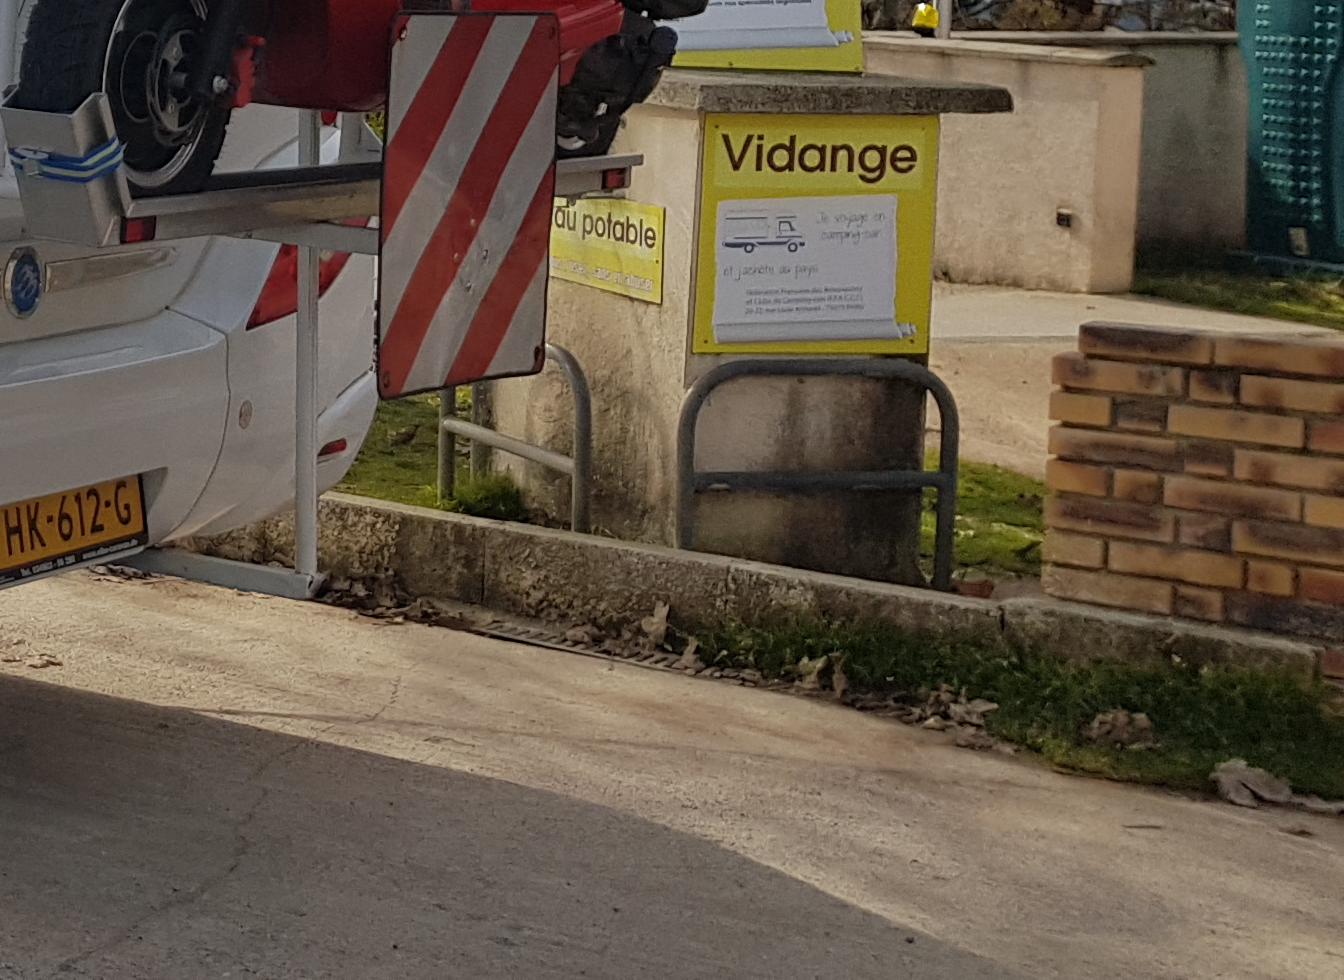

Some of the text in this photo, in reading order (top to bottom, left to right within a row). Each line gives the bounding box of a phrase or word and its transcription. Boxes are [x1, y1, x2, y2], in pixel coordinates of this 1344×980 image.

[721, 133, 918, 183] Vidange
[554, 207, 657, 249] au potable
[4, 480, 132, 556] HK-612-G
